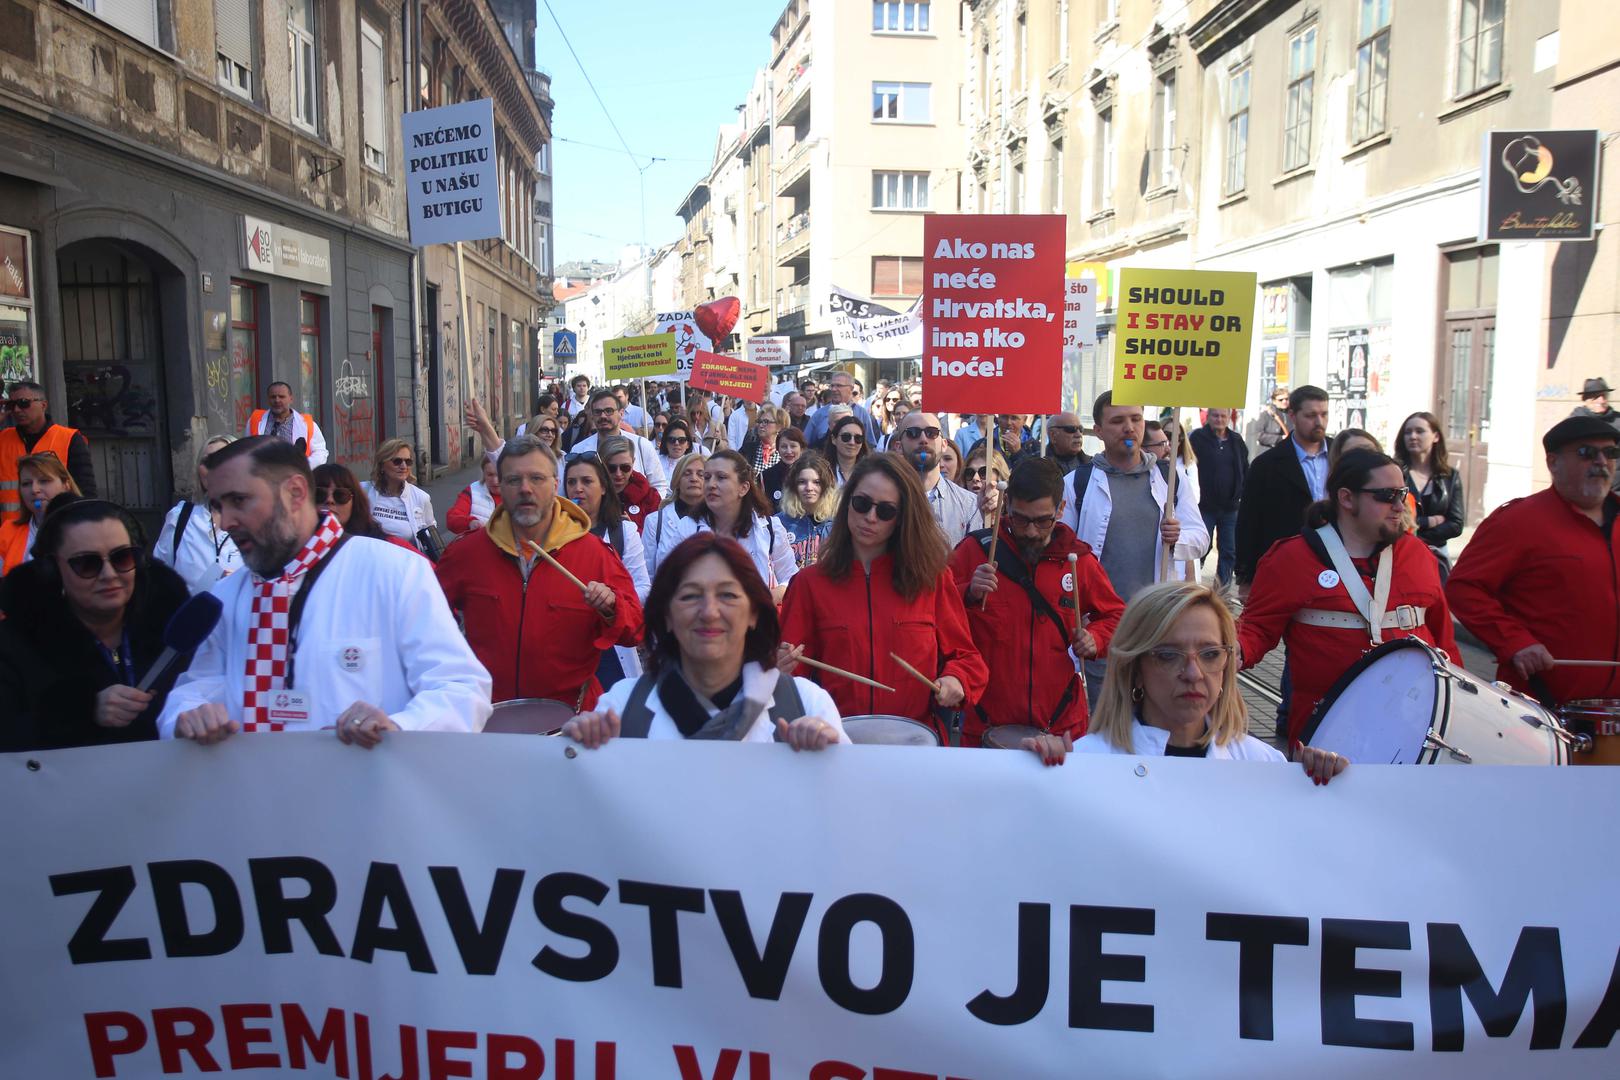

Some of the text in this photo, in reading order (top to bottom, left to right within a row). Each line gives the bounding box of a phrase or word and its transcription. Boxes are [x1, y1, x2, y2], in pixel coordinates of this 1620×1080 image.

[412, 124, 482, 148] NEĆEMO
[410, 147, 489, 173] POLITIKU
[421, 172, 480, 195] U NAŠU
[422, 198, 483, 219] BUTIGU
[933, 238, 1035, 259] Ako nas
[933, 268, 996, 289] neće
[1070, 282, 1088, 294] što
[1128, 287, 1225, 306] SHOULD
[658, 312, 695, 322] ZADA
[932, 298, 1055, 322] Hrvatska,
[876, 324, 910, 341] SATU!
[1127, 312, 1241, 332] I STAY OR
[932, 327, 1025, 348] ima tko
[1125, 338, 1220, 357] SHOULD
[931, 356, 1004, 377] hoće!
[1123, 363, 1188, 381] I GO?
[48, 856, 914, 1014] ZDRAVSTVO
[965, 902, 1155, 1032] JE
